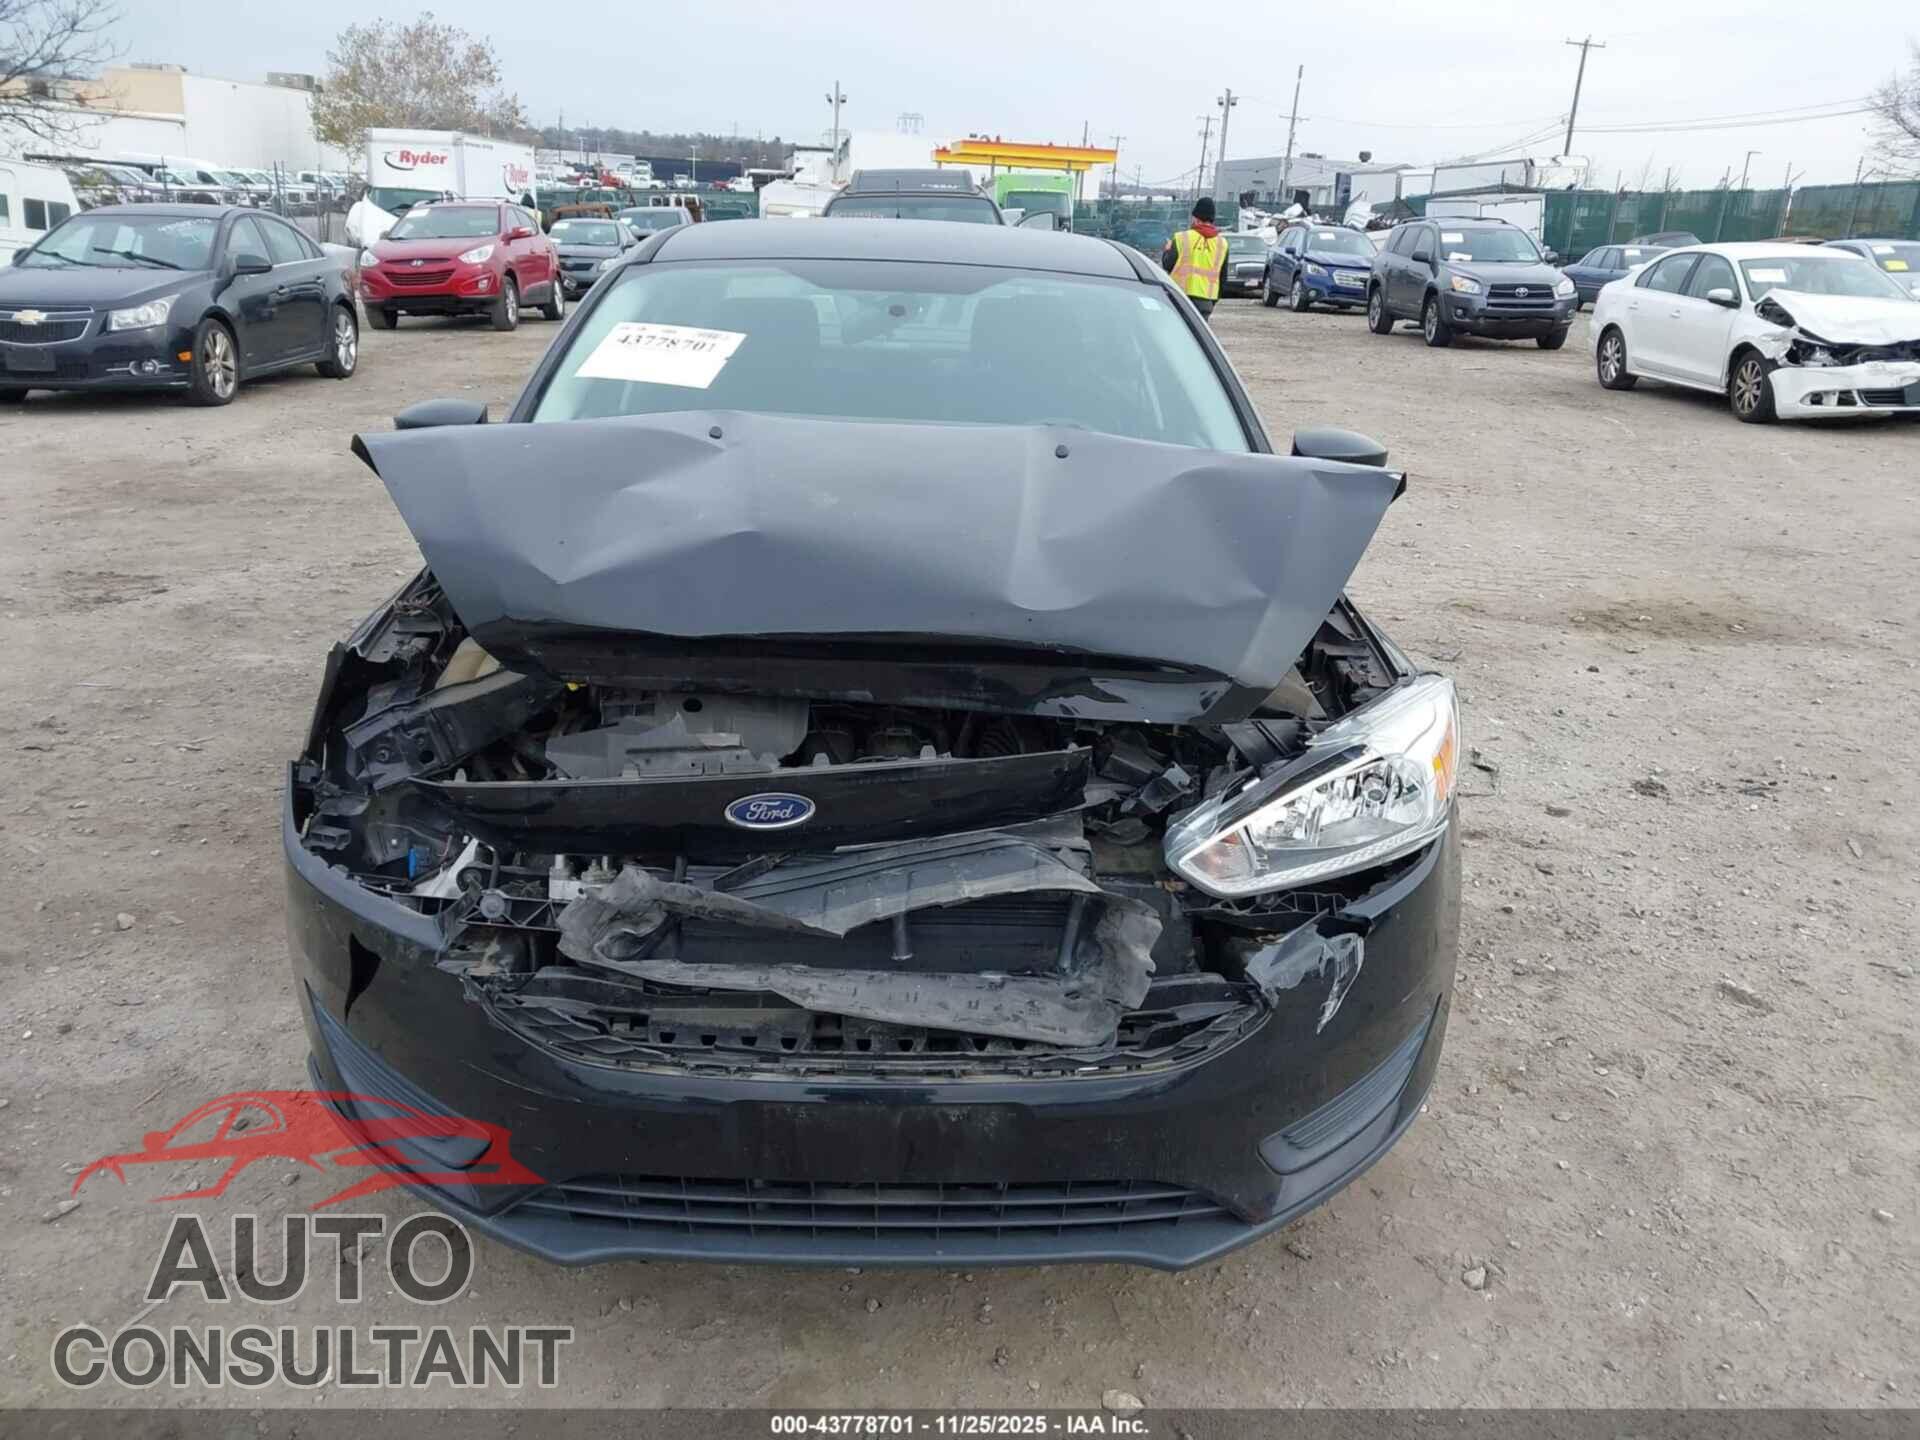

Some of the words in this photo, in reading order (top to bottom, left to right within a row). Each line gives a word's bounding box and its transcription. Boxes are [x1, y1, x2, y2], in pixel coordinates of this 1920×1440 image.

[400, 150, 447, 166] Ryder
[617, 334, 717, 353] 43778701
[746, 800, 795, 820] Ford
